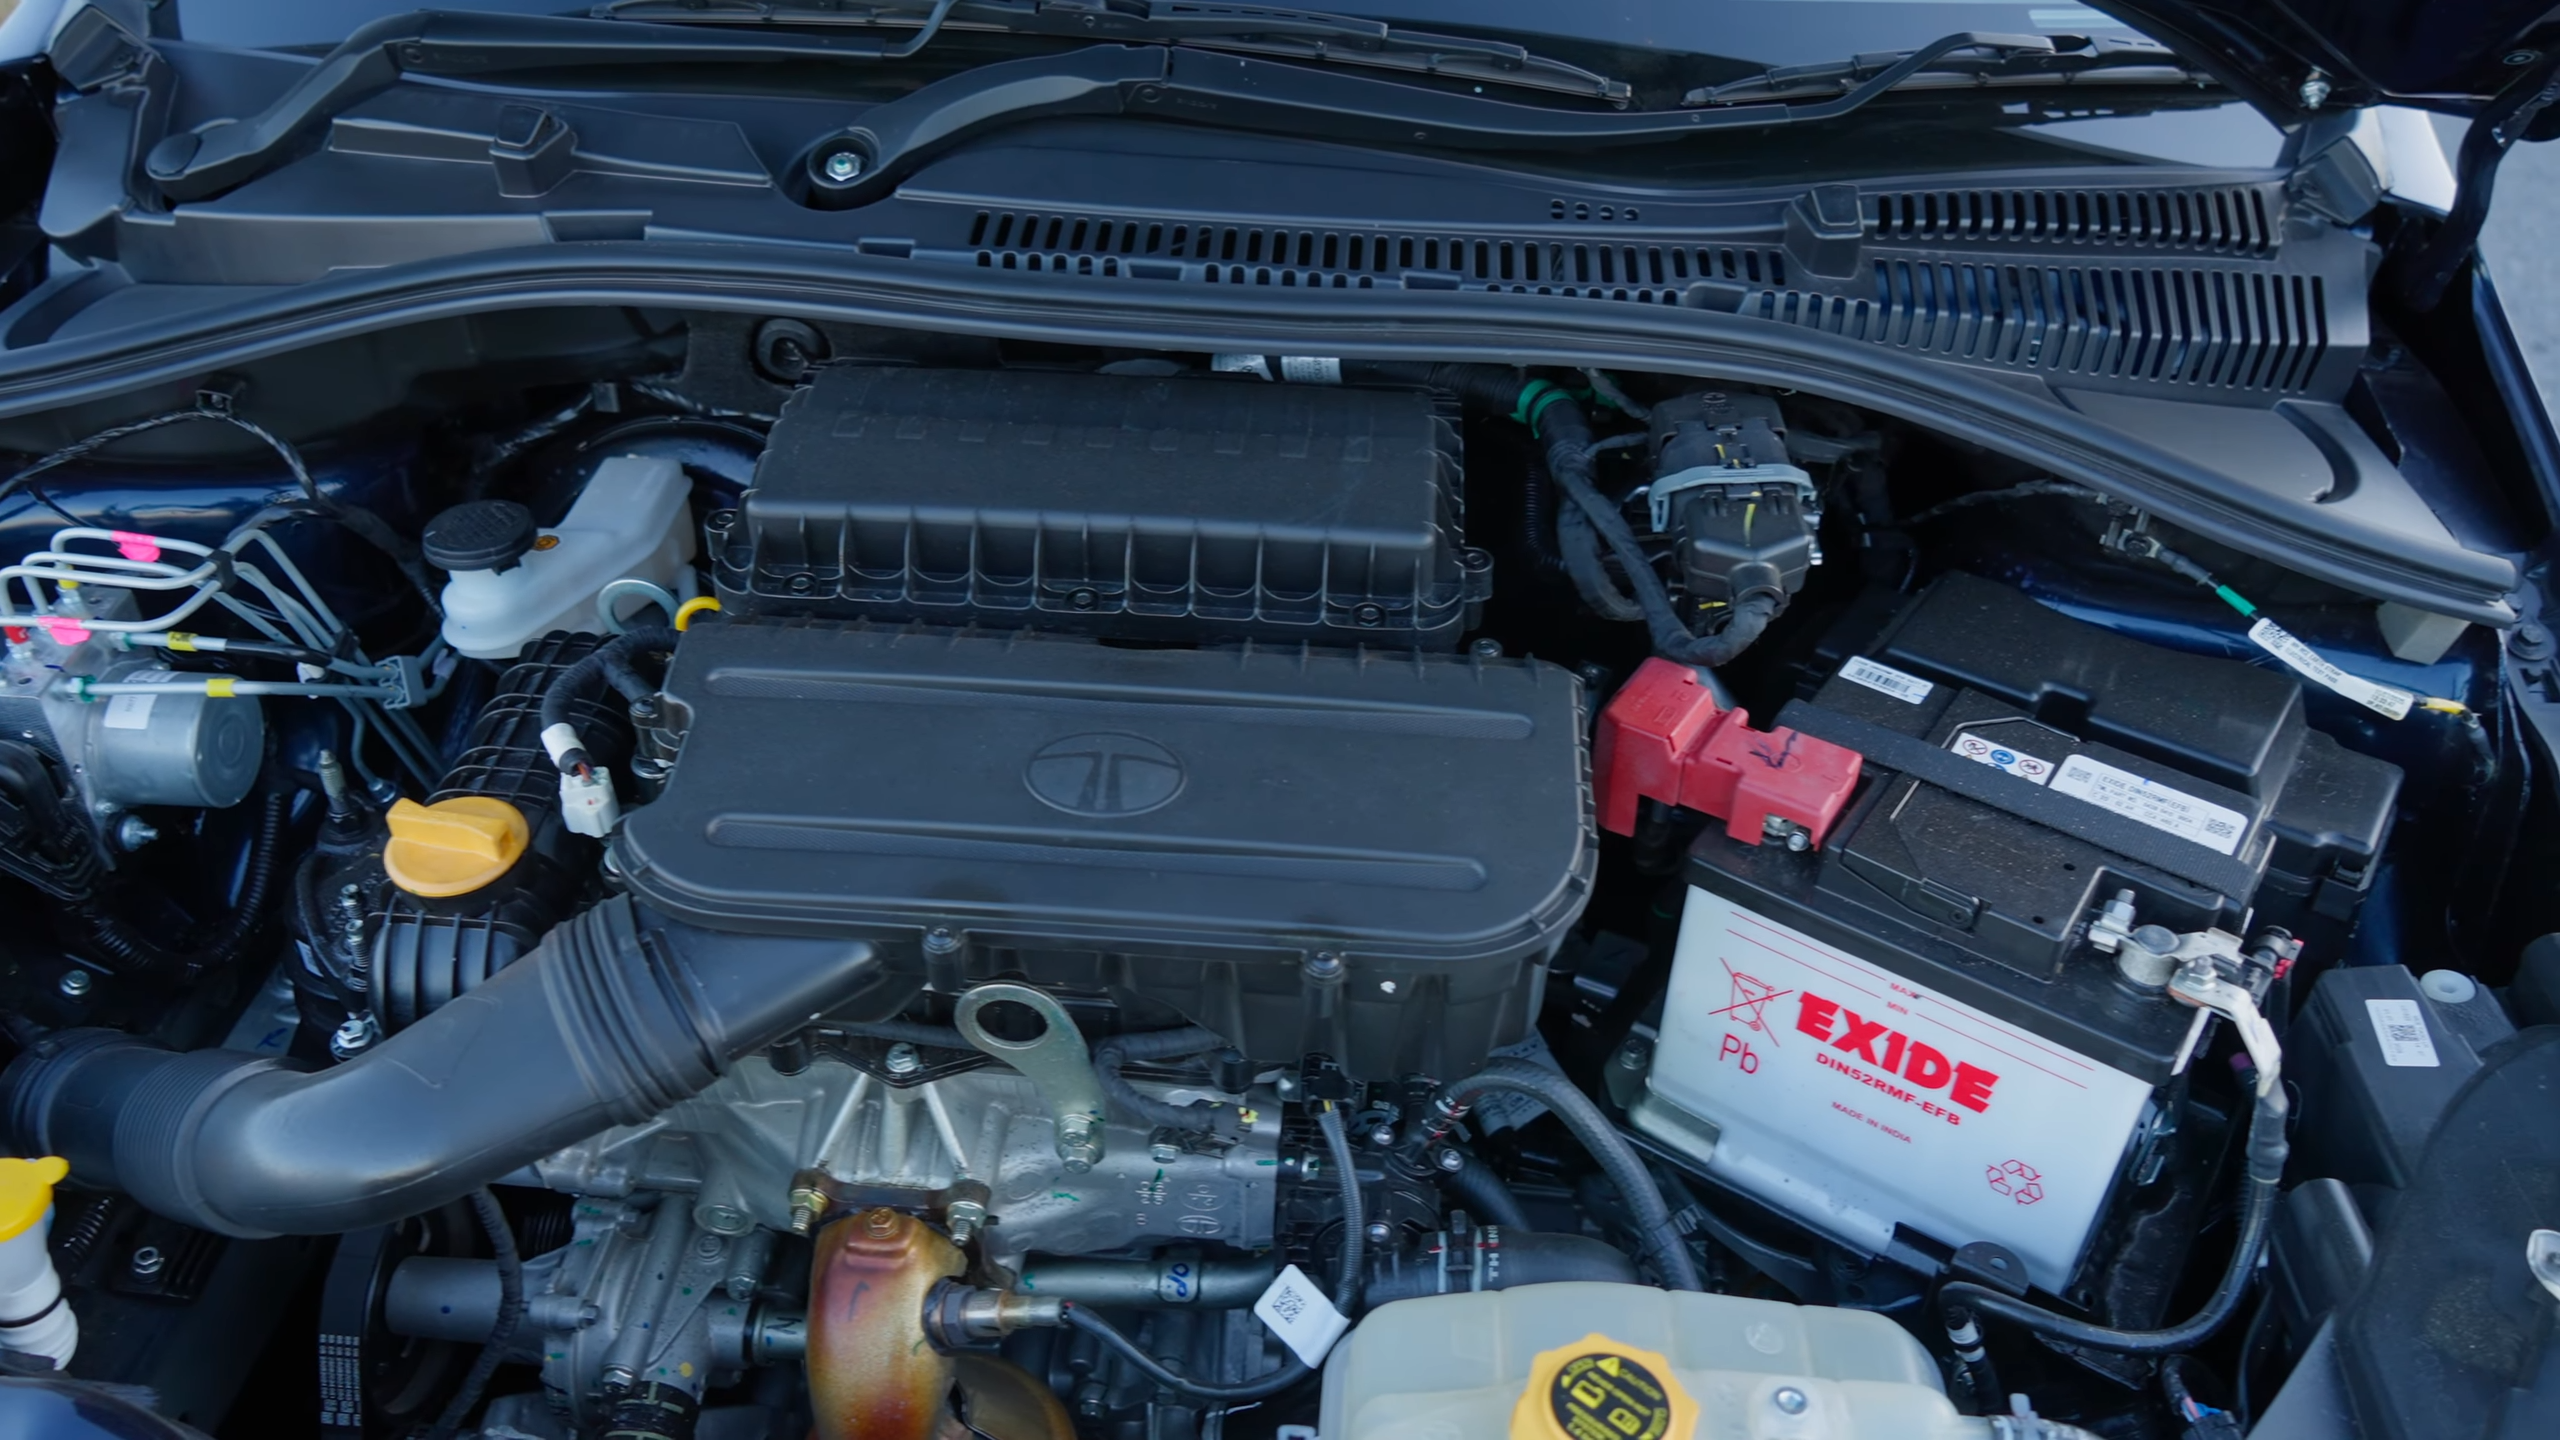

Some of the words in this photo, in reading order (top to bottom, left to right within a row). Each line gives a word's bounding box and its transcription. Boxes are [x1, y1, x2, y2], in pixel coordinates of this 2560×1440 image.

[1887, 1001, 1909, 1015] MIN
[1719, 1033, 1760, 1075] Pb
[1795, 991, 2000, 1114] EXIDE
[1816, 1052, 1962, 1127] DIN52RMF-EFB
[1832, 1101, 1864, 1121] MADE
[1866, 1116, 1879, 1128] IN
[1881, 1124, 1912, 1143] INDIA
[1620, 1368, 1662, 1401] CAUTION
